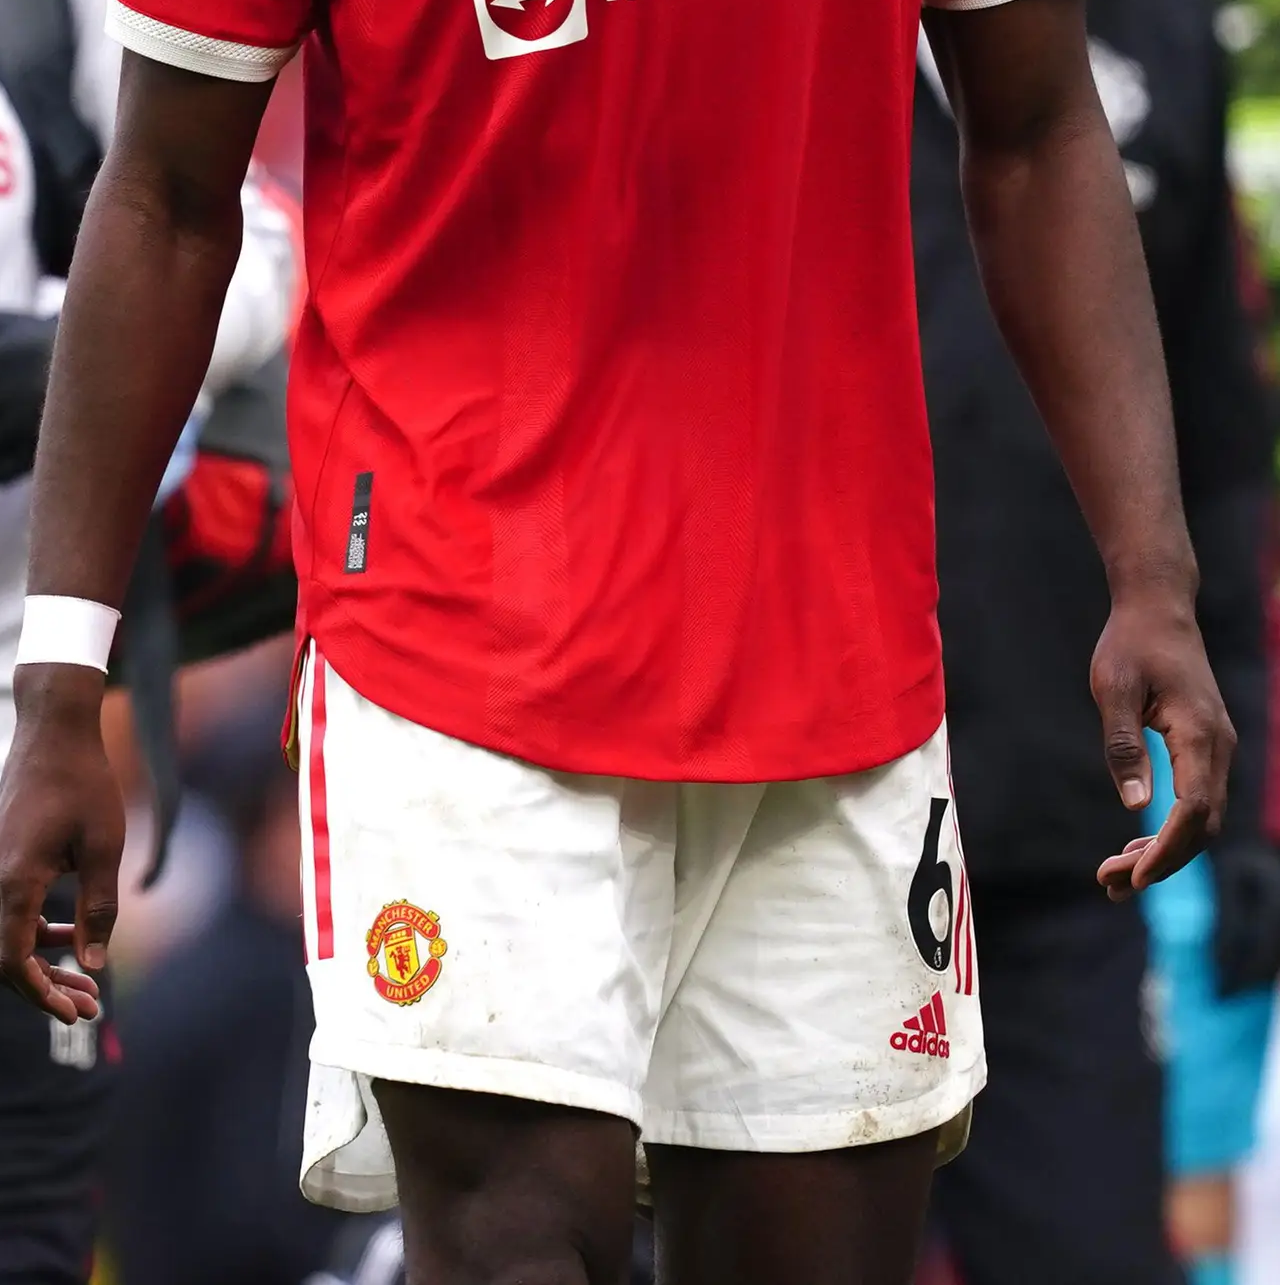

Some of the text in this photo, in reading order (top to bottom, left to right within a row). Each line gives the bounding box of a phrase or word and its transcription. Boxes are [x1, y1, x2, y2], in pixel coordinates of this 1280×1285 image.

[907, 797, 954, 972] 6
[370, 906, 433, 950] MANCHESTER
[386, 974, 430, 999] UNITED
[889, 1029, 950, 1059] adidas
